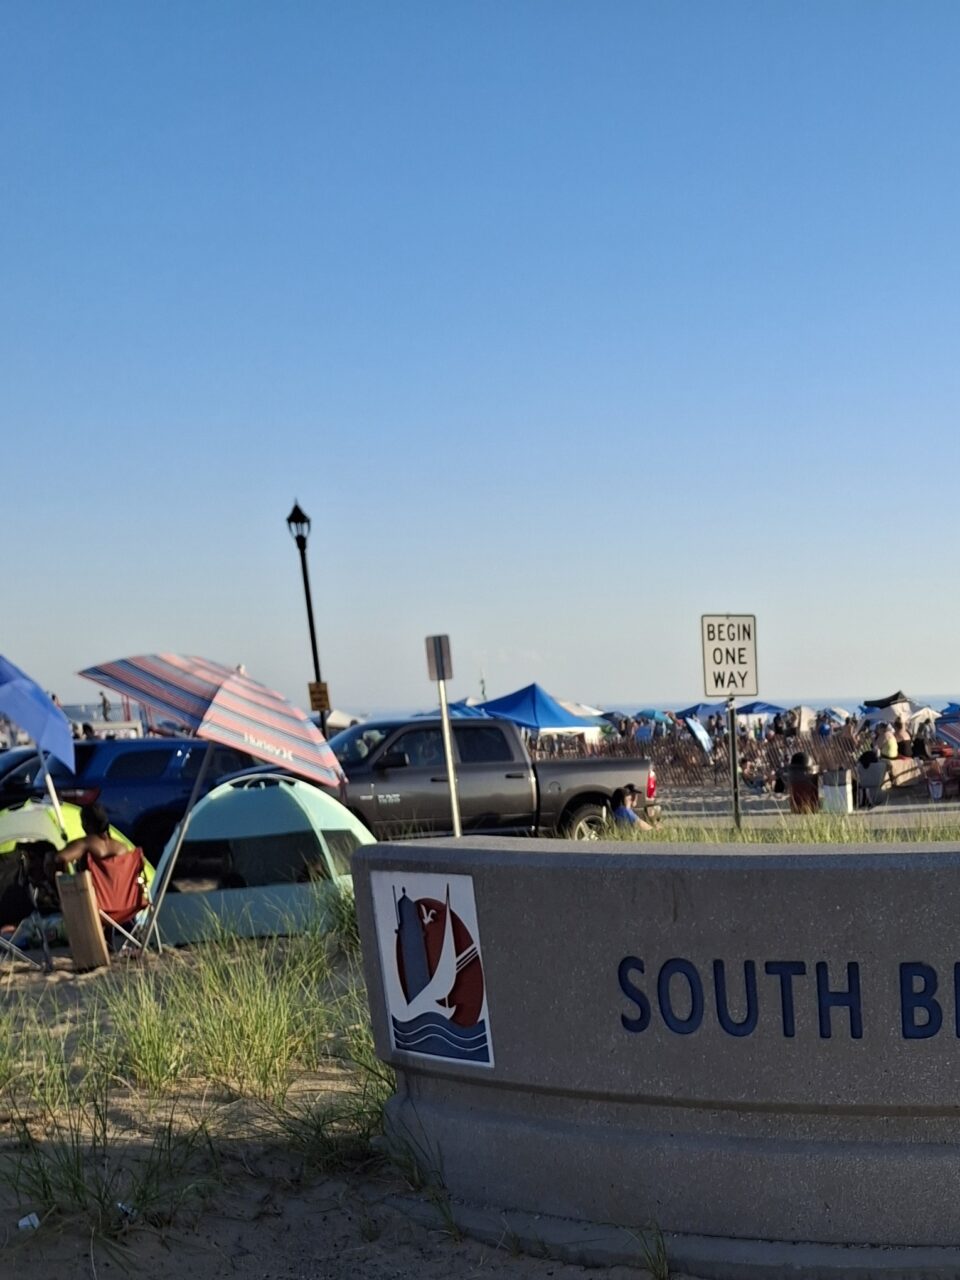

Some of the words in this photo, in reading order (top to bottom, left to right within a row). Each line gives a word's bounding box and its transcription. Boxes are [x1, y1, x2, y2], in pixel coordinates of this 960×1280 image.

[707, 623, 751, 641] BEGIN
[712, 647, 747, 665] ONE
[713, 671, 748, 689] WAY
[617, 956, 864, 1039] SOUTH
